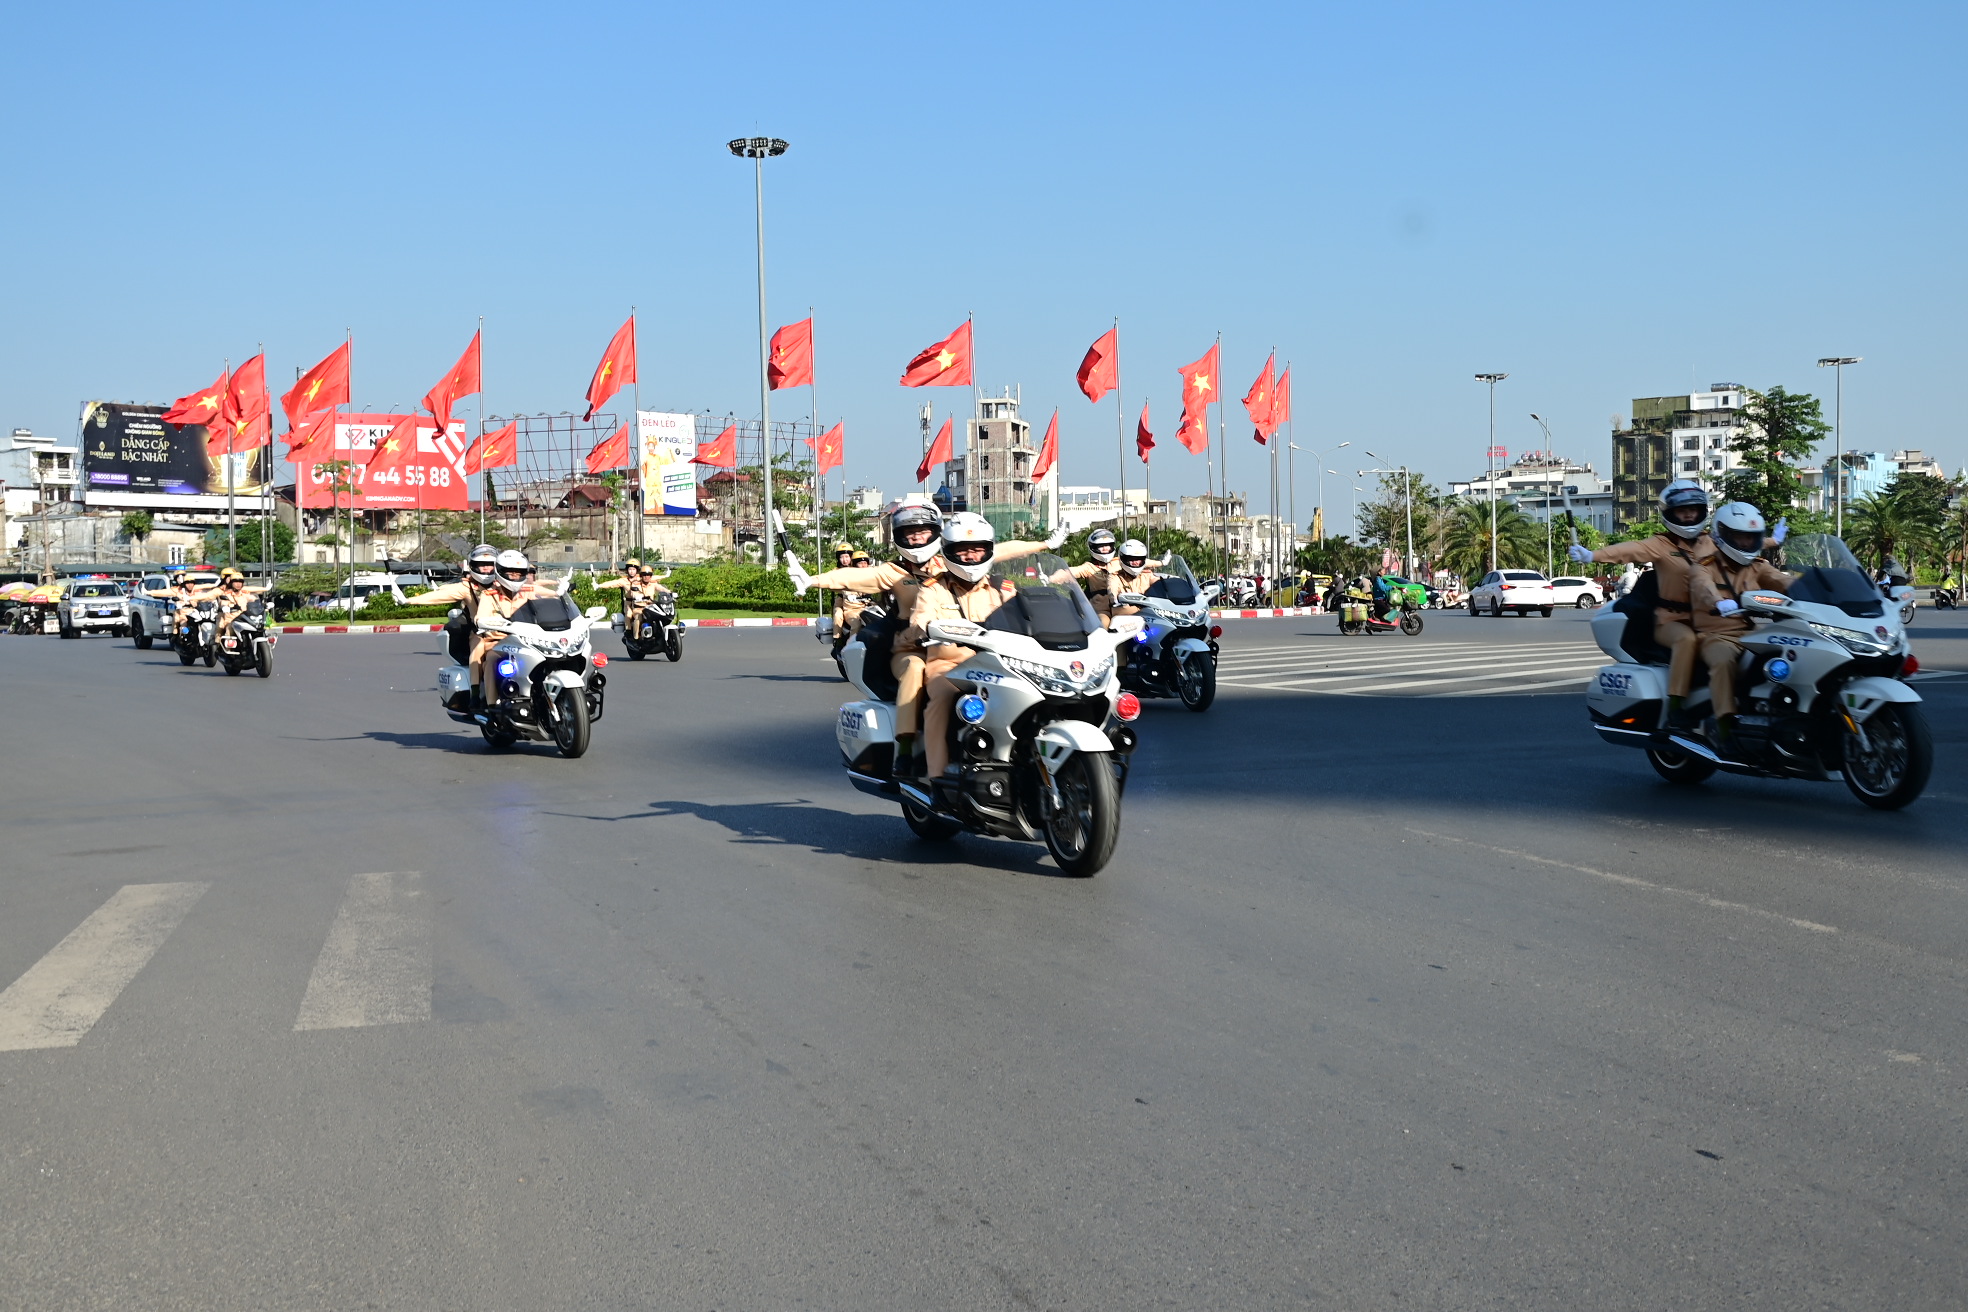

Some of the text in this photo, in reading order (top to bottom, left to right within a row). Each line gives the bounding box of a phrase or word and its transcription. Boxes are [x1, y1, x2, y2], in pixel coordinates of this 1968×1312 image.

[151, 437, 170, 450] CẤP
[121, 449, 169, 463] BẬC NHẤT
[373, 466, 400, 485] 44
[430, 466, 450, 487] 88
[1767, 635, 1814, 648] CSGT
[966, 670, 1004, 684] CSGT
[1599, 672, 1632, 689] CSGT
[841, 710, 863, 730] CSGT
